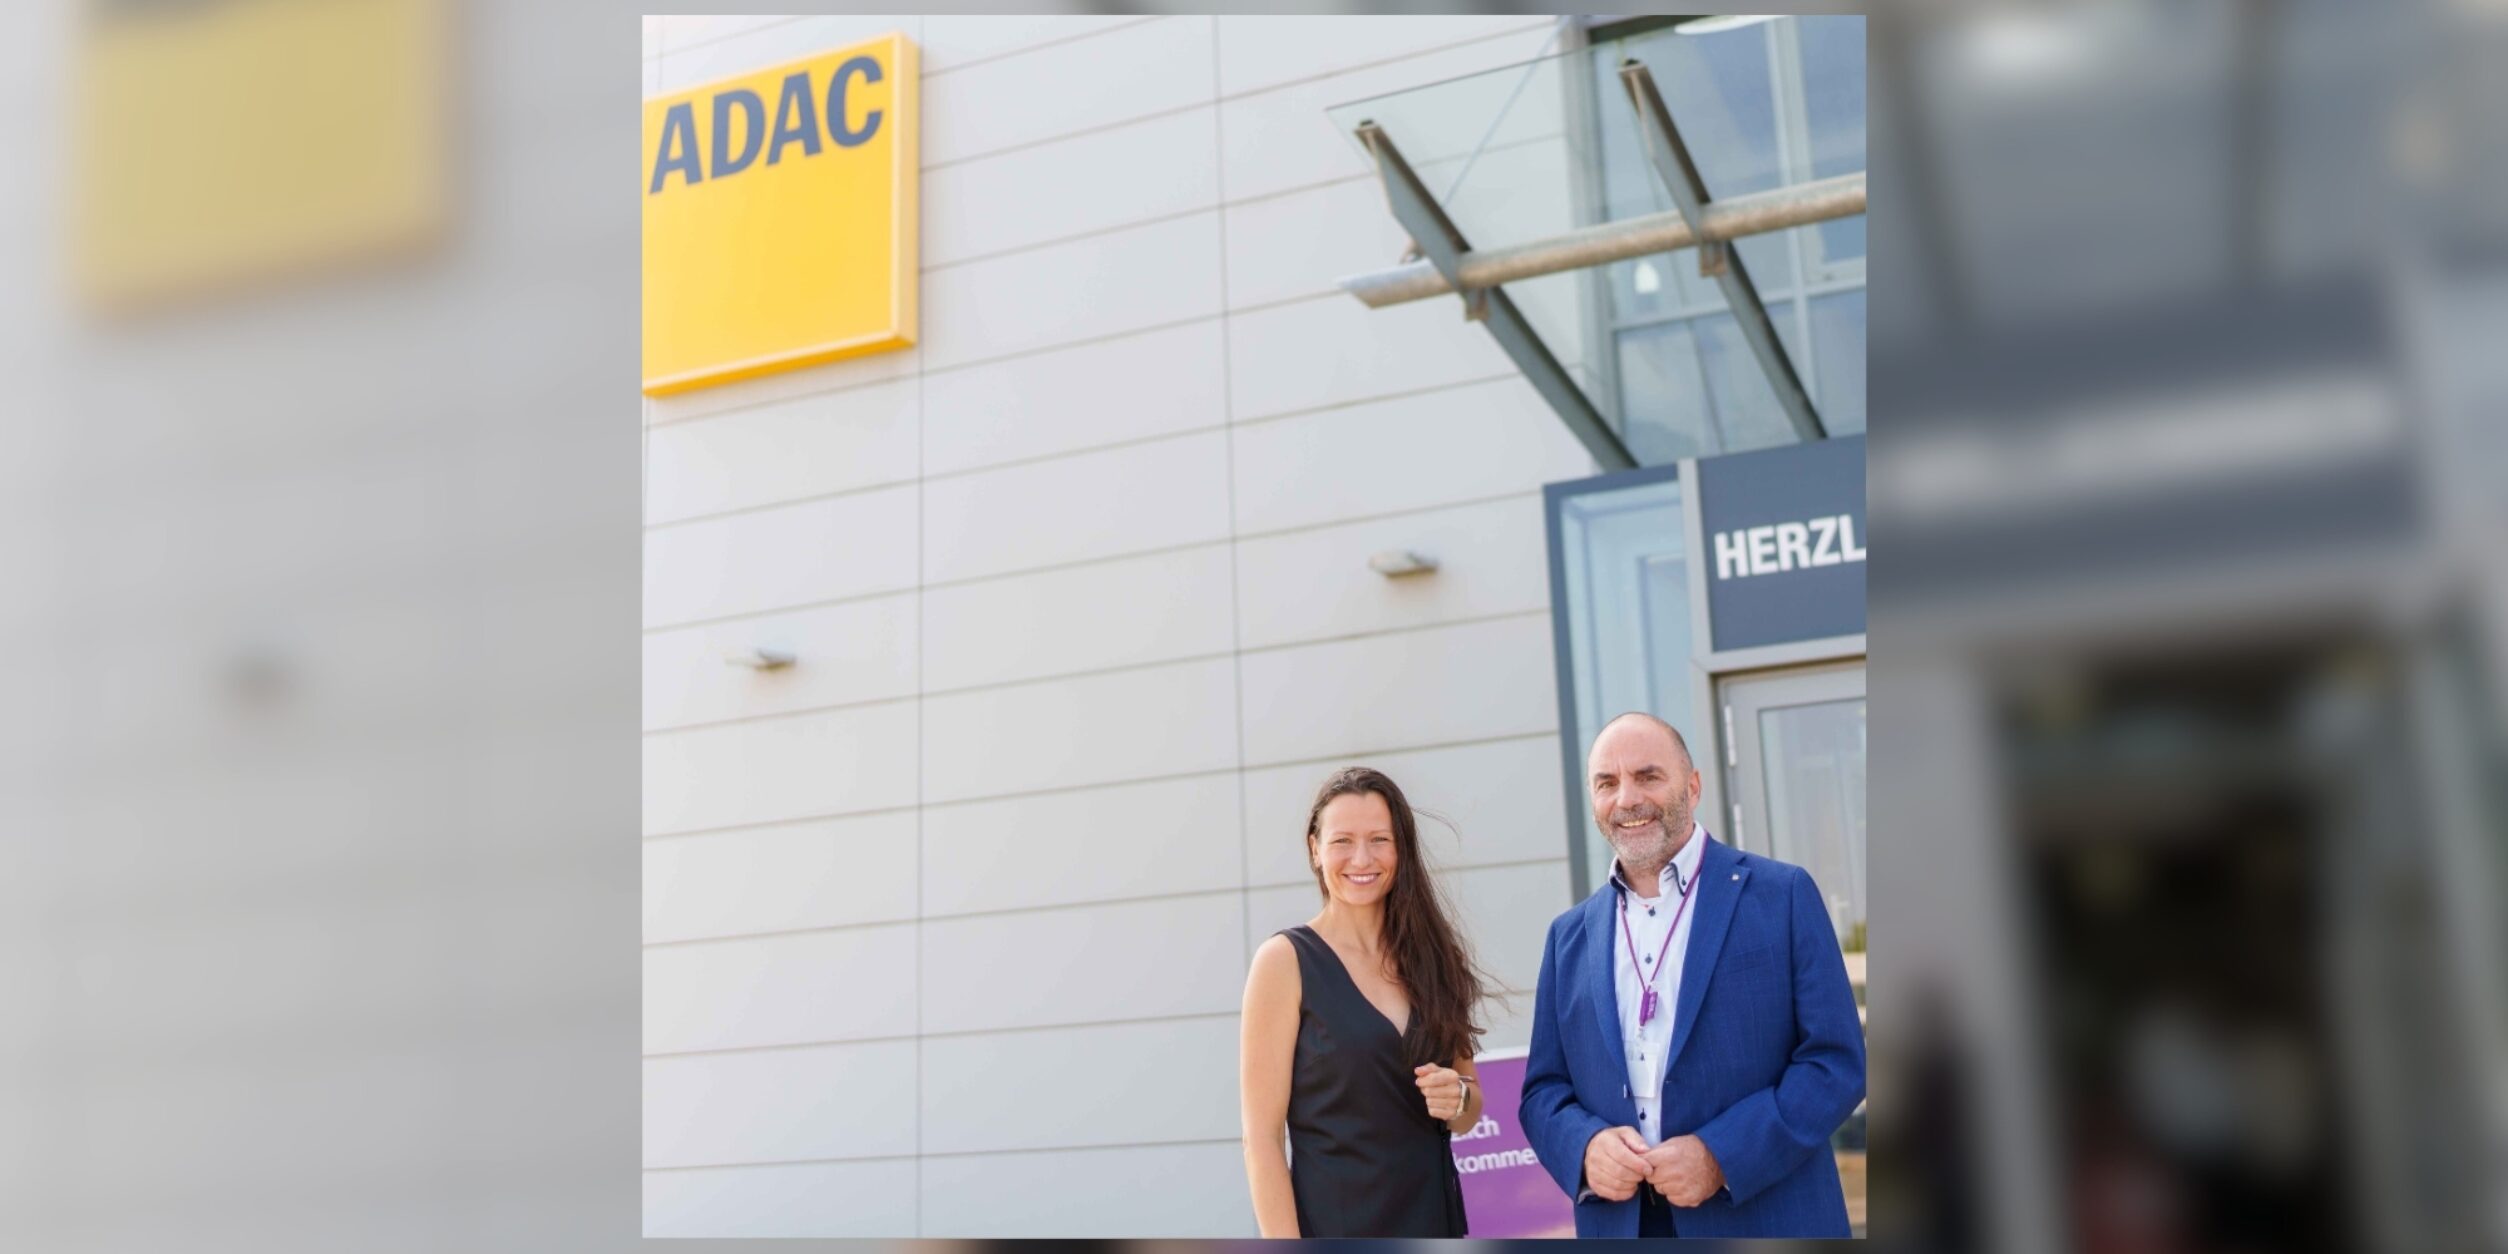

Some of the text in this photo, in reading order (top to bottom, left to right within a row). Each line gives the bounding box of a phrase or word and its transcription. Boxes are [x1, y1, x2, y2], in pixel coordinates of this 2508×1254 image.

[649, 55, 883, 195] ADAC
[1714, 514, 1867, 580] HERZL
[1452, 1148, 1540, 1174] komme
